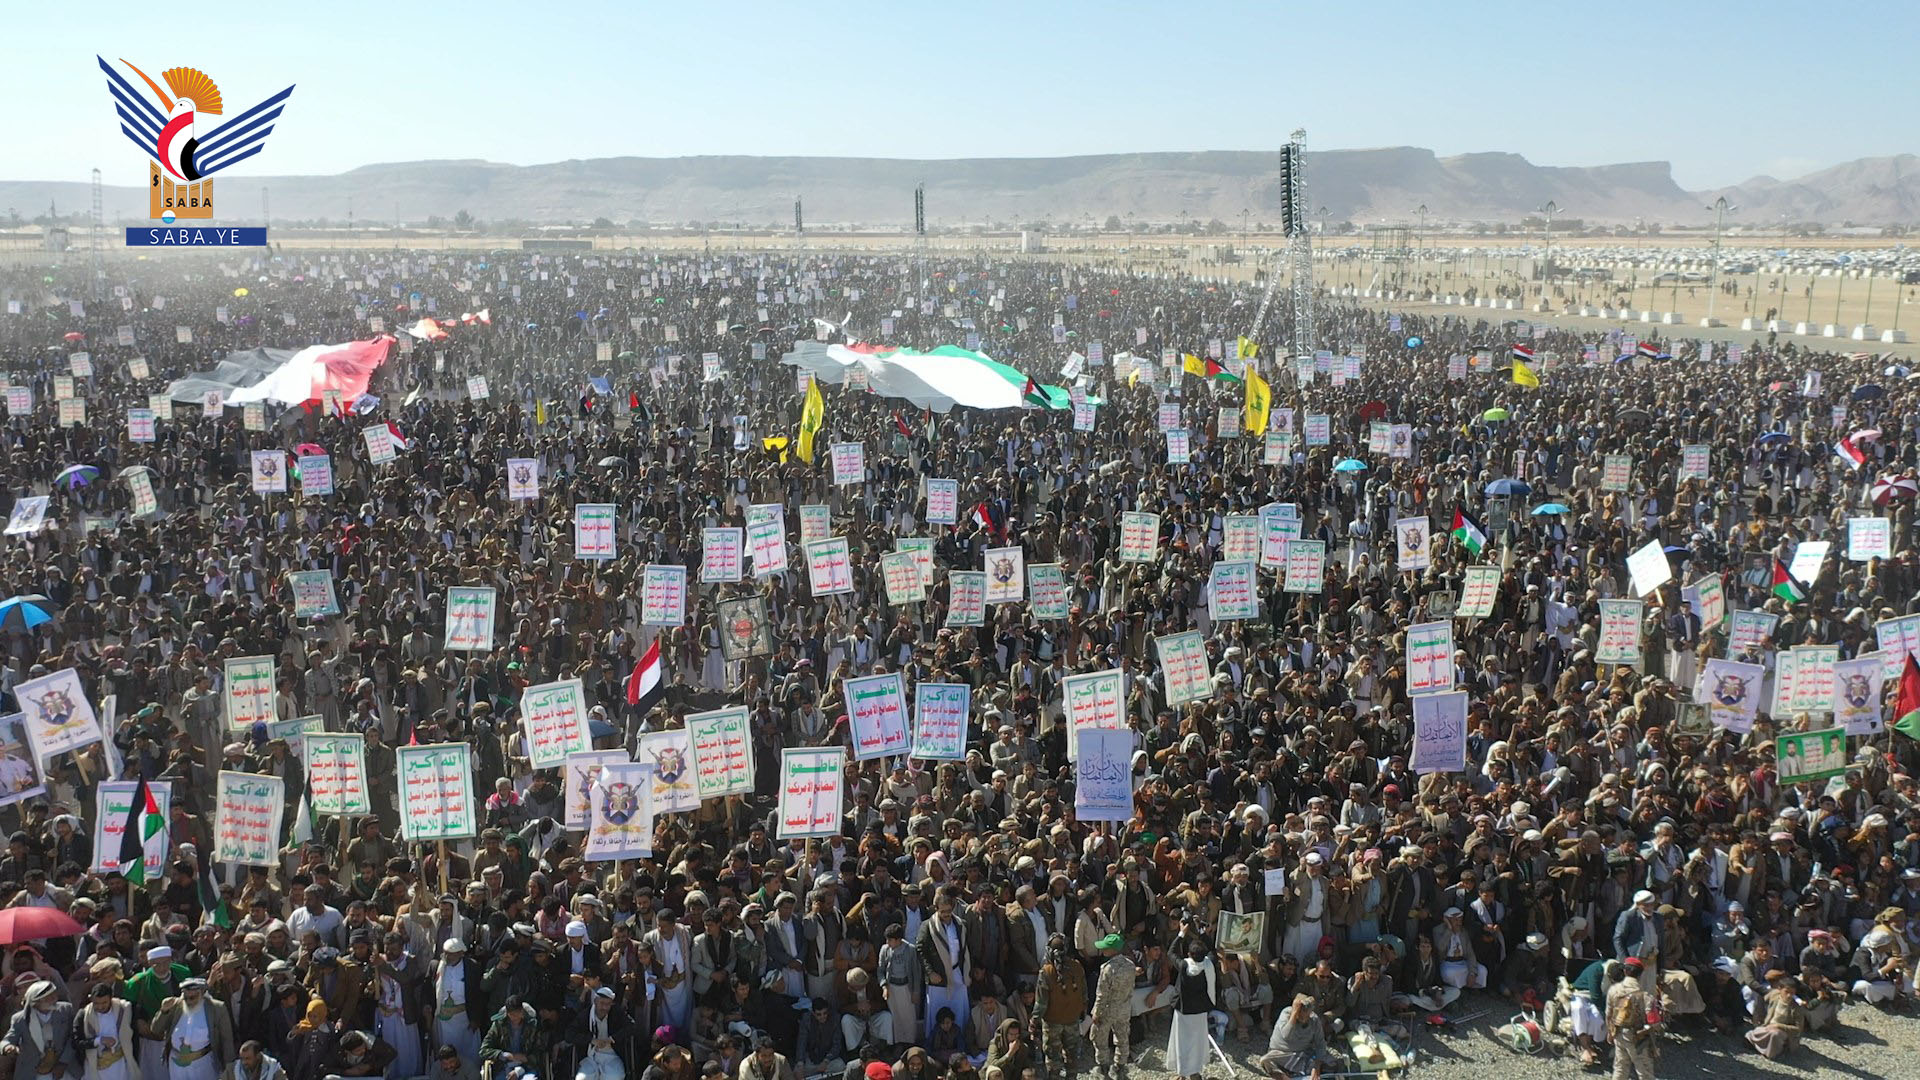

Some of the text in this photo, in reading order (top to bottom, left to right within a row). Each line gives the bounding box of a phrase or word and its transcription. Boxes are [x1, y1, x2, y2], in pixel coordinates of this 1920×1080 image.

[853, 686, 897, 704] قاطعوا
[1071, 678, 1115, 700] الله أكبر
[528, 691, 574, 711] الله أكبر
[695, 719, 742, 741] الله أكبر
[311, 739, 357, 758] الله أكبر
[407, 750, 462, 771] الله أكبر
[789, 759, 838, 776] قاطعوا
